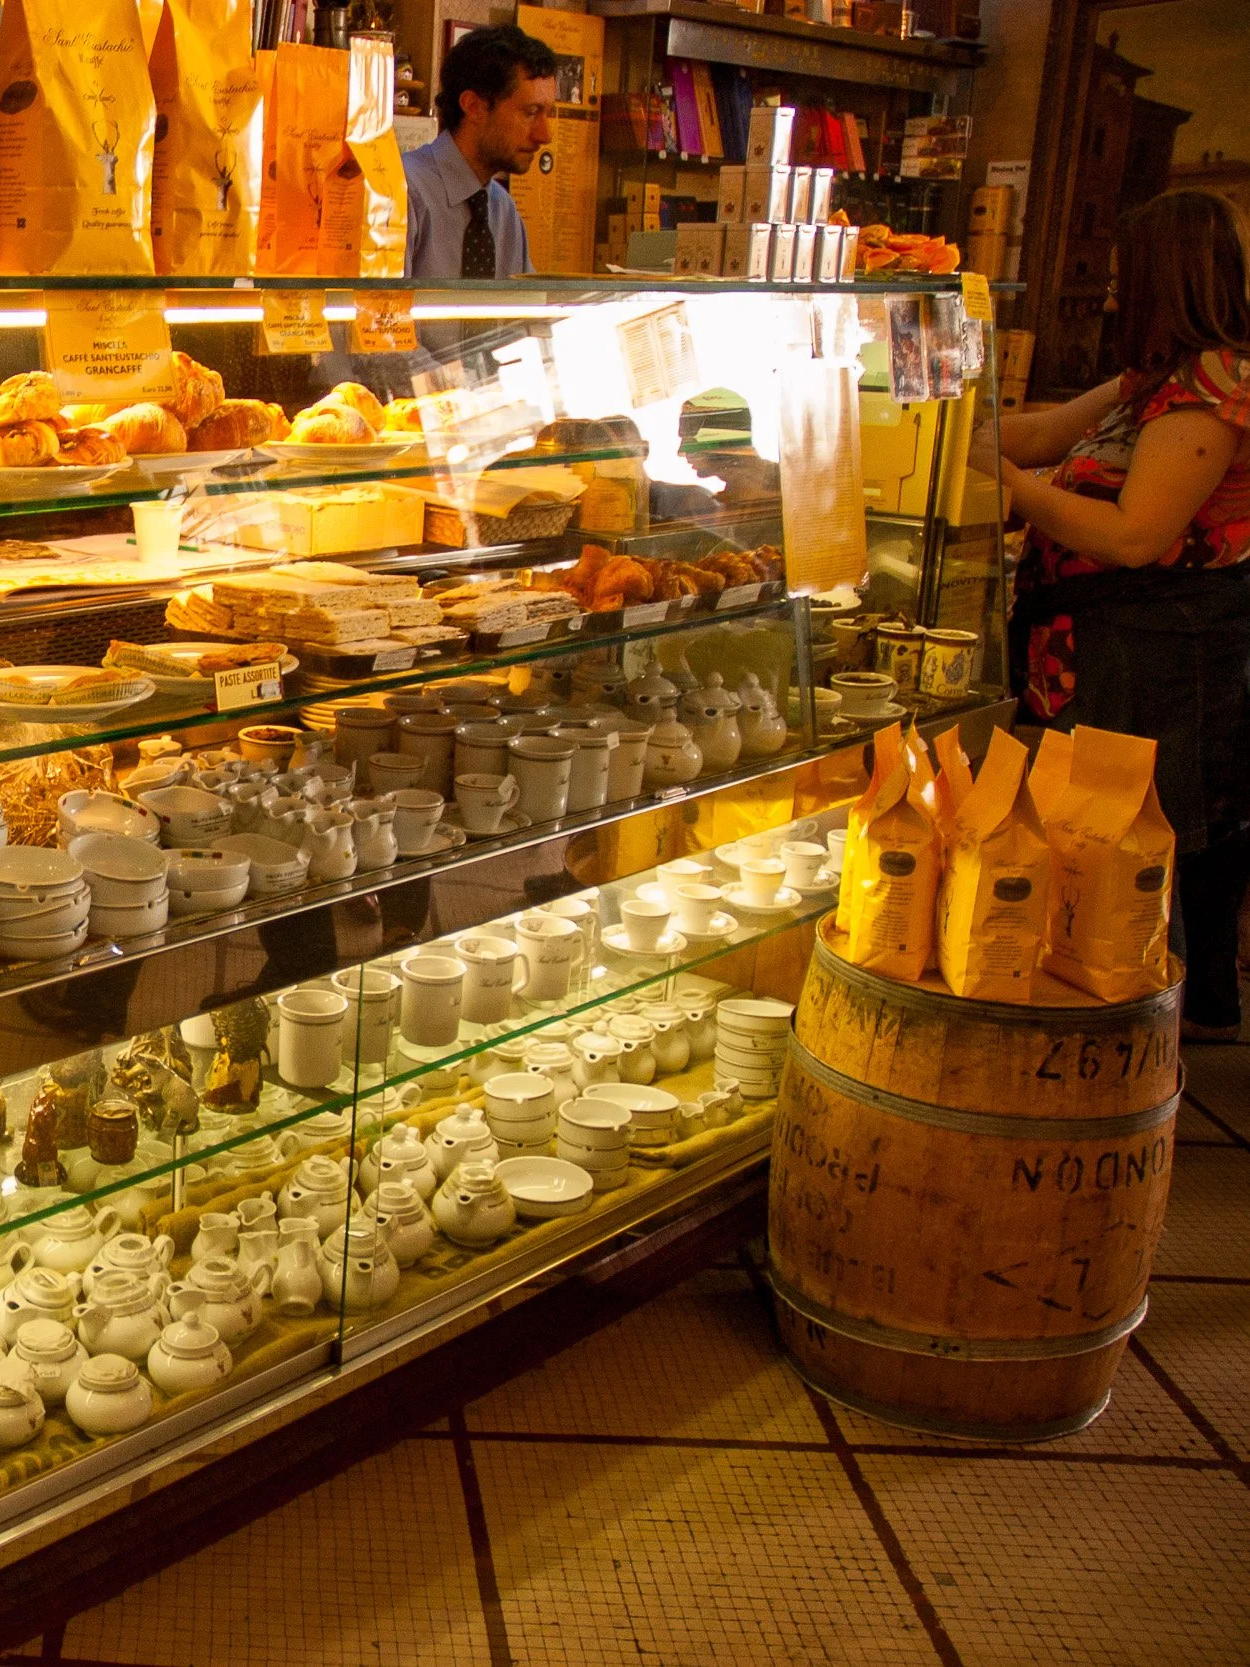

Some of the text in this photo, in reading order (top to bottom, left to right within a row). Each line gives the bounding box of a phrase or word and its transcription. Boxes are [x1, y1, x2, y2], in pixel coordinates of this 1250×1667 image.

[92, 341, 128, 350] MISCELA
[219, 666, 278, 688] PASTE ASSORTITE
